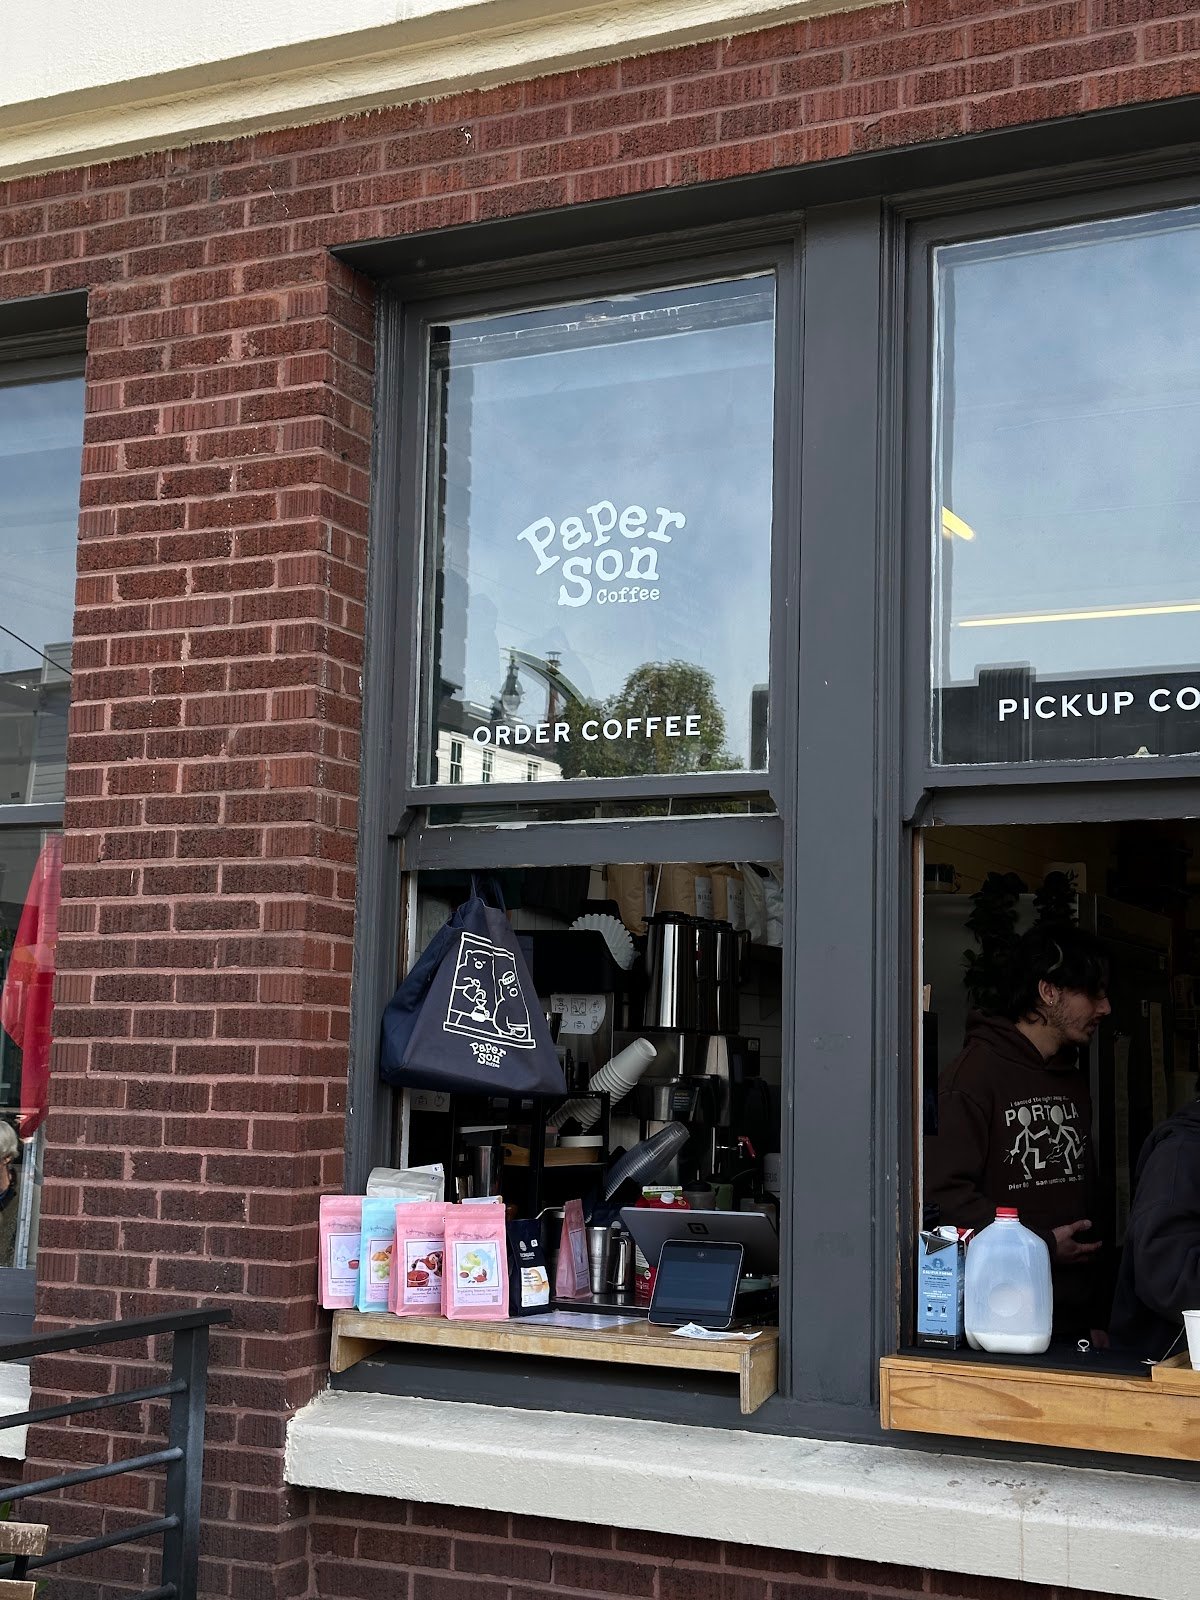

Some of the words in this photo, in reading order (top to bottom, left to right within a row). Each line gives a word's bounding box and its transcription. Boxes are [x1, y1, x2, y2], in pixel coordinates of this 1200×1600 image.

[516, 500, 687, 575] Paper
[557, 546, 660, 607] Son
[596, 586, 660, 604] Coffee
[998, 691, 1134, 722] PICKUP
[1148, 686, 1200, 712] CO
[472, 721, 570, 746] ORDER
[581, 714, 701, 740] COFFEE
[469, 1042, 507, 1057] Paper
[477, 1052, 501, 1065] Son
